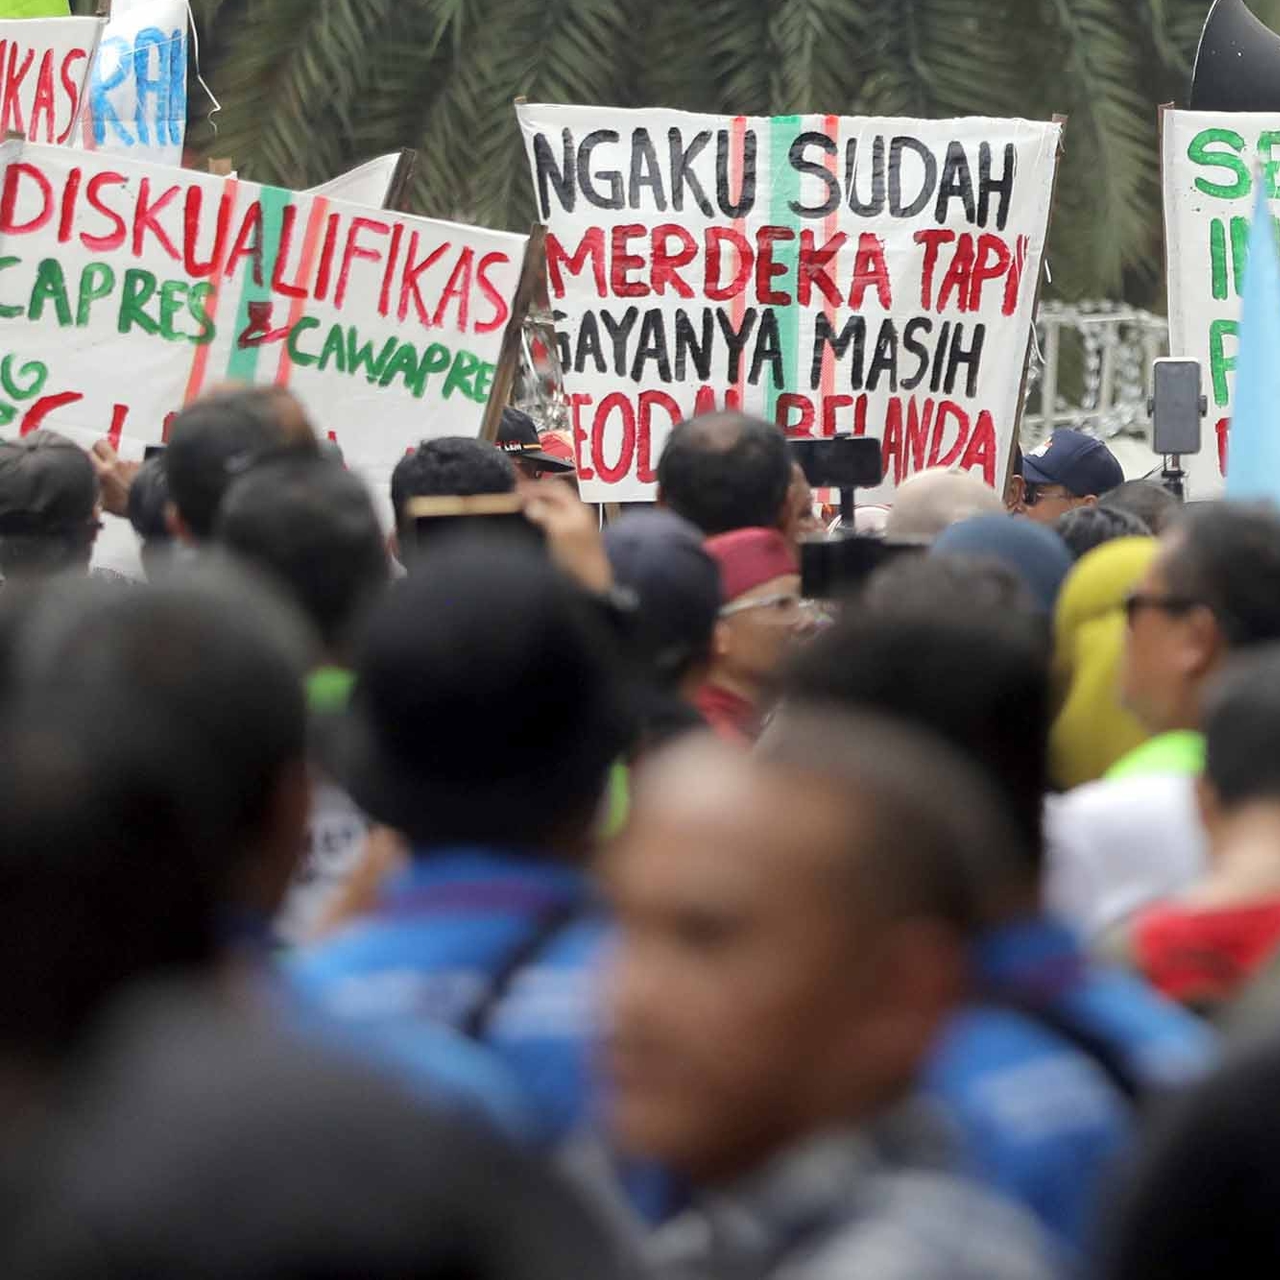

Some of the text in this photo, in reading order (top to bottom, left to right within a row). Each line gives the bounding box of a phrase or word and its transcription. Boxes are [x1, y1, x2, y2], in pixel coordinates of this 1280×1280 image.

[533, 127, 1016, 230] NGAKU SUDAH
[545, 224, 1029, 315] MERDEKA TAPI
[810, 313, 986, 397] MASIH
